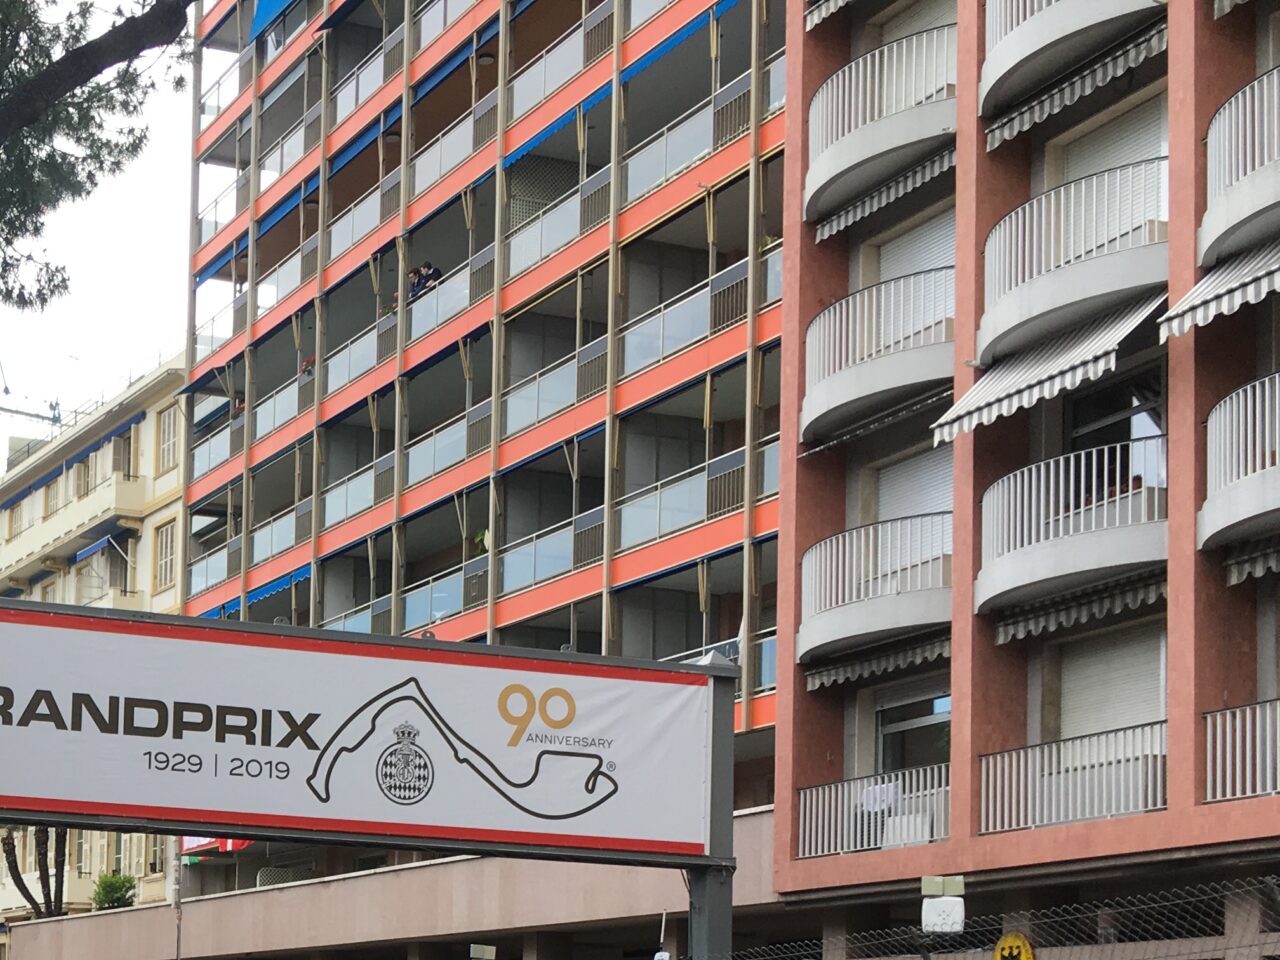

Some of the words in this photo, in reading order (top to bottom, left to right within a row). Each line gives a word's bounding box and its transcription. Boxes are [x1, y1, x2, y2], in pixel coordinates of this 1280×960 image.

[497, 683, 577, 748] 90
[525, 732, 614, 750] ANNIVERSARY
[143, 750, 203, 774] 1929
[229, 756, 291, 780] 2019
